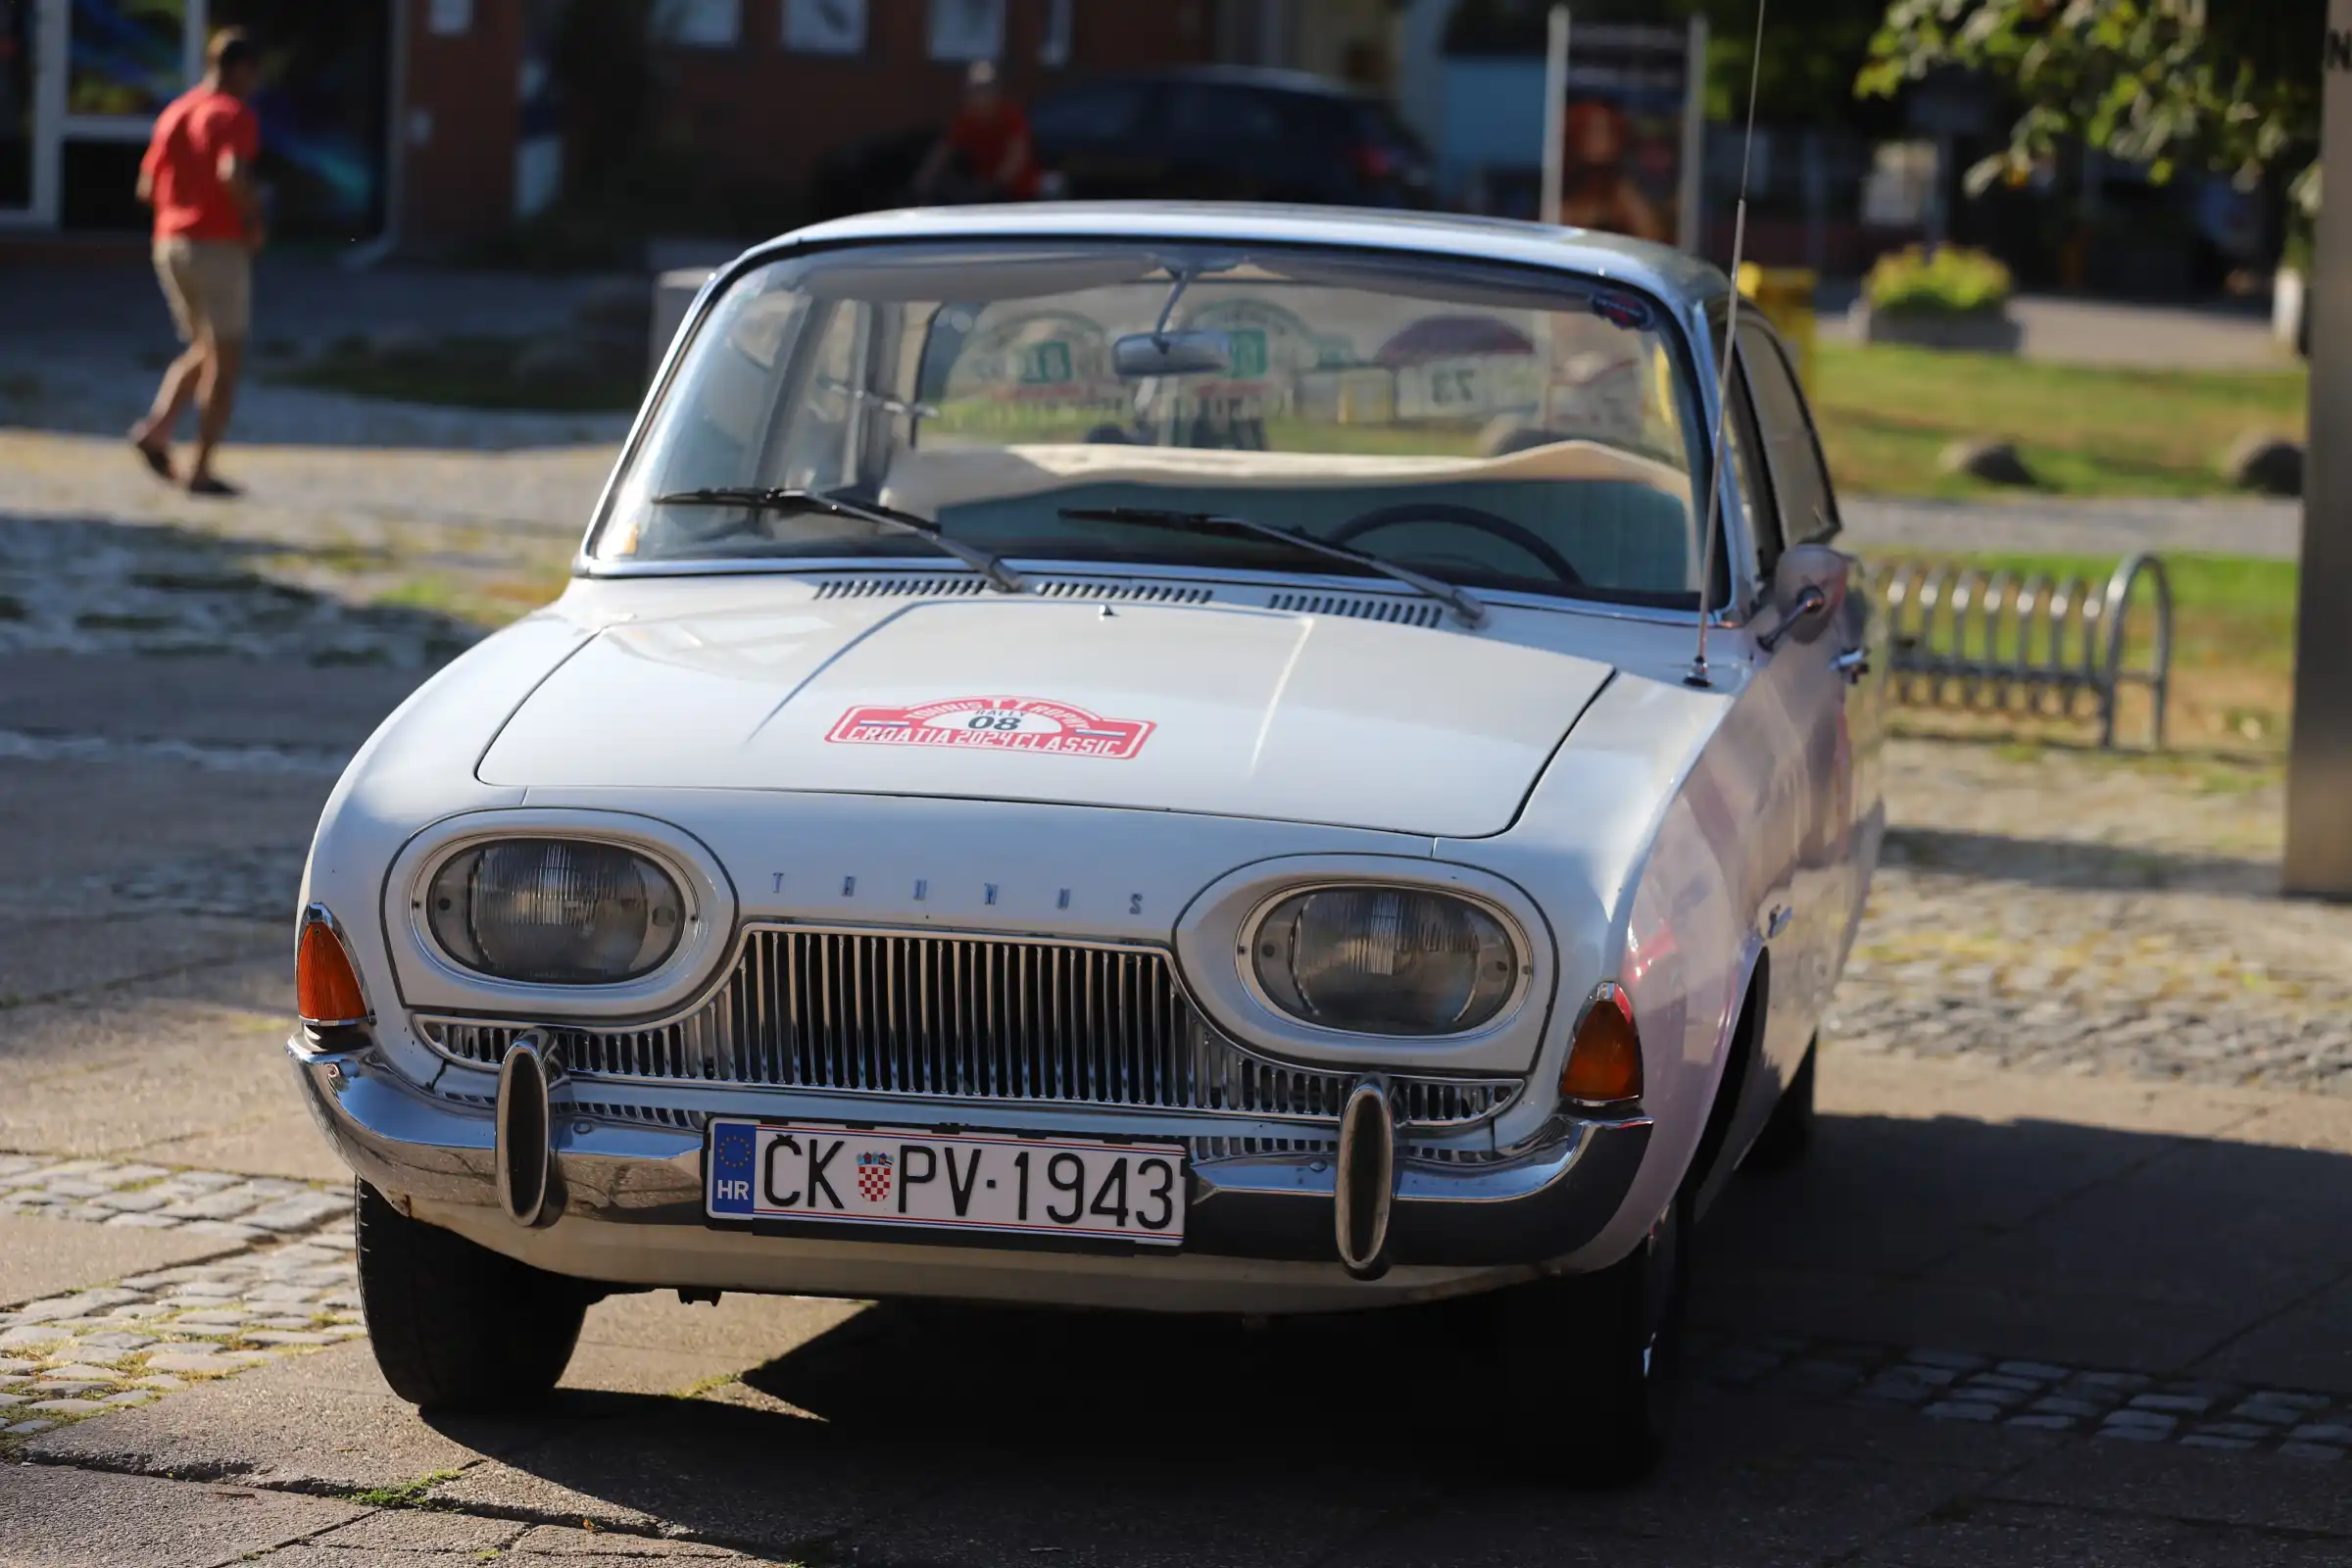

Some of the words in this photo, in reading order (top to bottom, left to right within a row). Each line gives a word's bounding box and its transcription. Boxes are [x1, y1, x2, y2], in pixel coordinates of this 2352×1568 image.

[967, 715, 1022, 731] 08
[847, 725, 952, 745] CROATIA
[954, 730, 1014, 747] 2024
[1012, 733, 1121, 757] CLASSIC
[763, 1133, 846, 1210] ČK
[717, 1178, 750, 1201] HR
